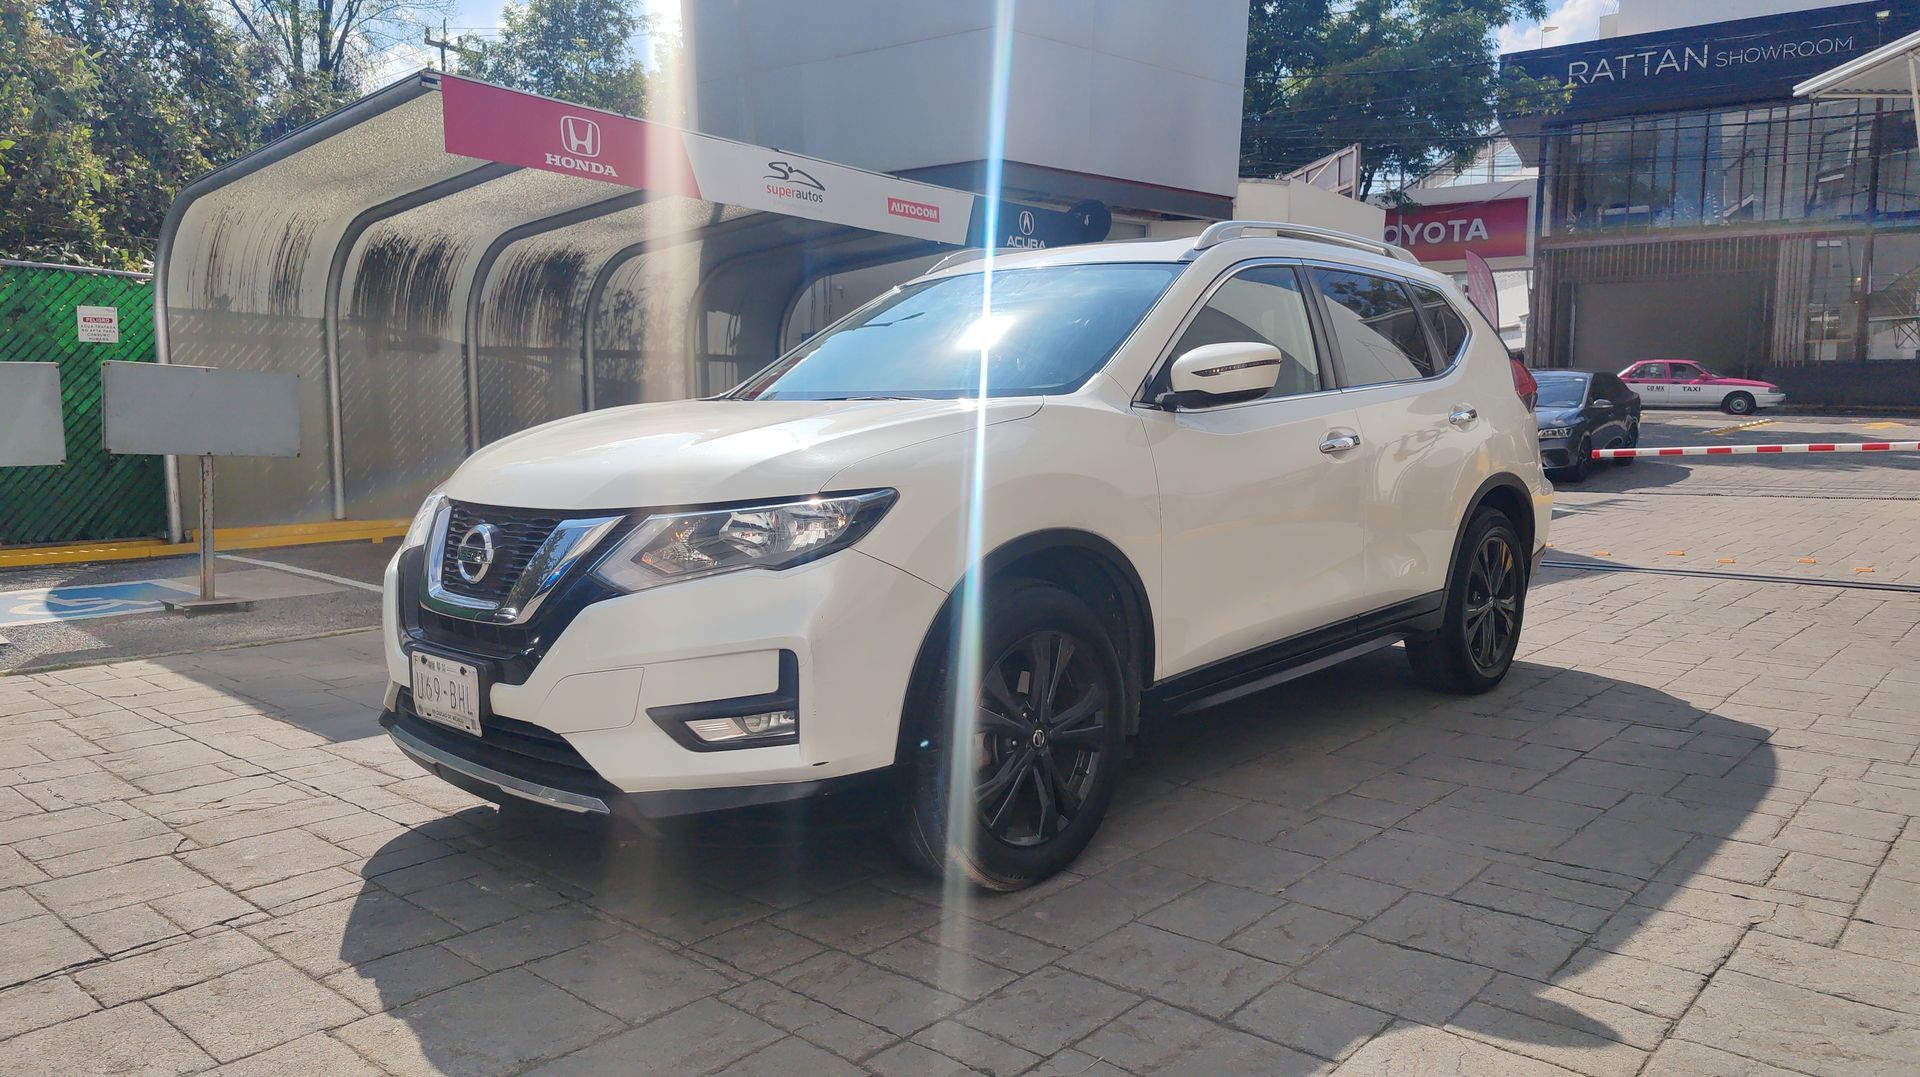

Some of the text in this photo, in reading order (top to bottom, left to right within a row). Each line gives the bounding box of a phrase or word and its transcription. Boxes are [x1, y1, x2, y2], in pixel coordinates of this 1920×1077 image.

[1568, 36, 1854, 84] RATTAN SHOWROOM
[545, 152, 619, 177] HONDA
[766, 184, 824, 203] superautos
[890, 201, 938, 220] AUTOCOM
[1006, 235, 1046, 249] ACURA
[1384, 217, 1489, 246] OYOTA
[416, 671, 474, 716] U69-BHL
